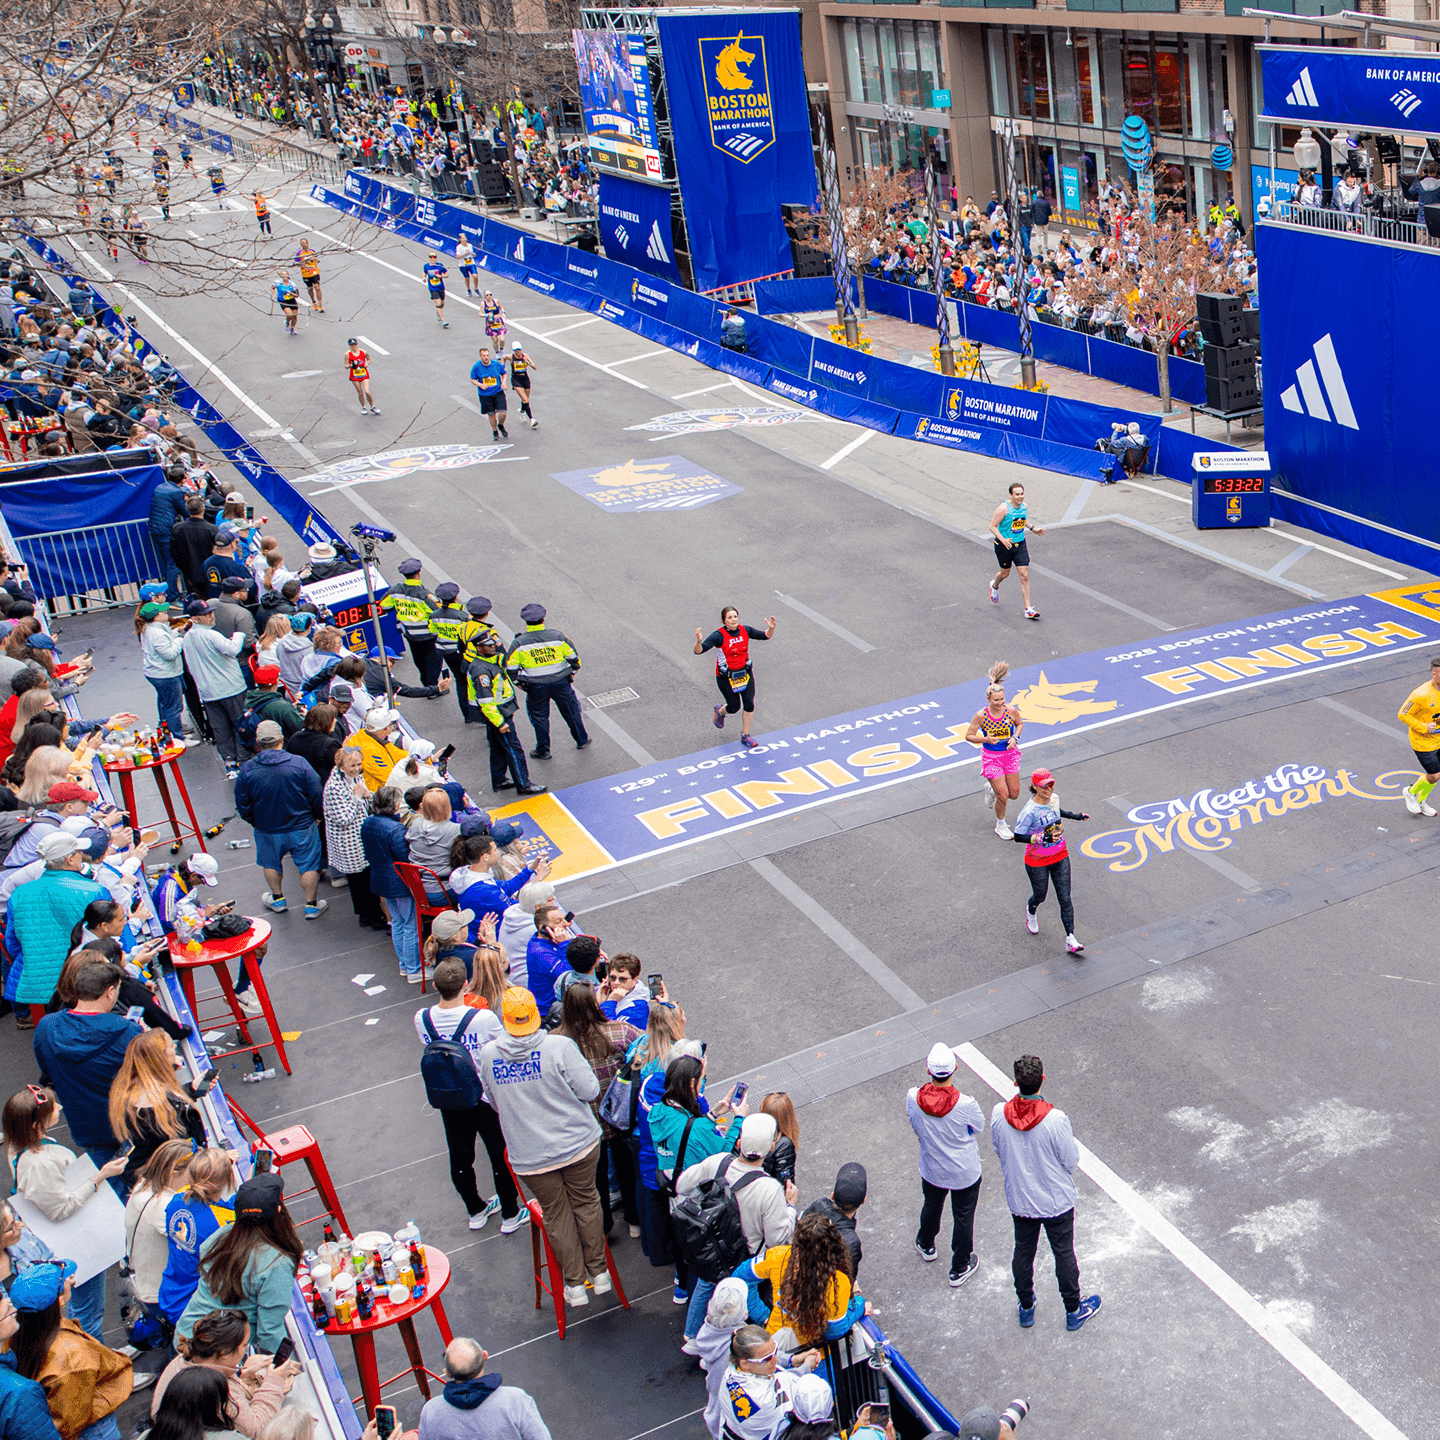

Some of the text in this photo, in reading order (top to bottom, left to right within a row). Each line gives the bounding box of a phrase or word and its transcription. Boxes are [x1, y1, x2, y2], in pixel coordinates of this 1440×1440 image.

[1366, 68, 1391, 80] BANK
[1392, 70, 1404, 80] OF
[709, 93, 768, 110] BOSTON
[712, 107, 770, 120] MARATHON
[602, 204, 640, 224] BANK OF AMERICA
[814, 360, 854, 382] BANK OF AMERICA
[772, 380, 808, 398] BANK OF AMERICA
[964, 410, 978, 419] BANK
[986, 414, 1011, 426] AMERICA
[965, 396, 1038, 422] BOSTON MARATHON
[930, 422, 982, 440] BOSTON MARATHON
[632, 474, 713, 491] BOSTON
[1214, 478, 1262, 492] 5:33:22
[311, 584, 338, 596] BOSTON
[1104, 604, 1360, 664] 2025 BOSTON MARATHON
[530, 647, 556, 657] BOSTON
[534, 654, 556, 664] POLICE
[1141, 621, 1427, 695] FINISH
[610, 701, 940, 794] 129TH BOSTON MARATHON
[634, 721, 986, 840] FINISH
[1126, 763, 1326, 834] Meet the
[1080, 768, 1424, 872] Moment
[492, 1061, 541, 1079] BOSTON
